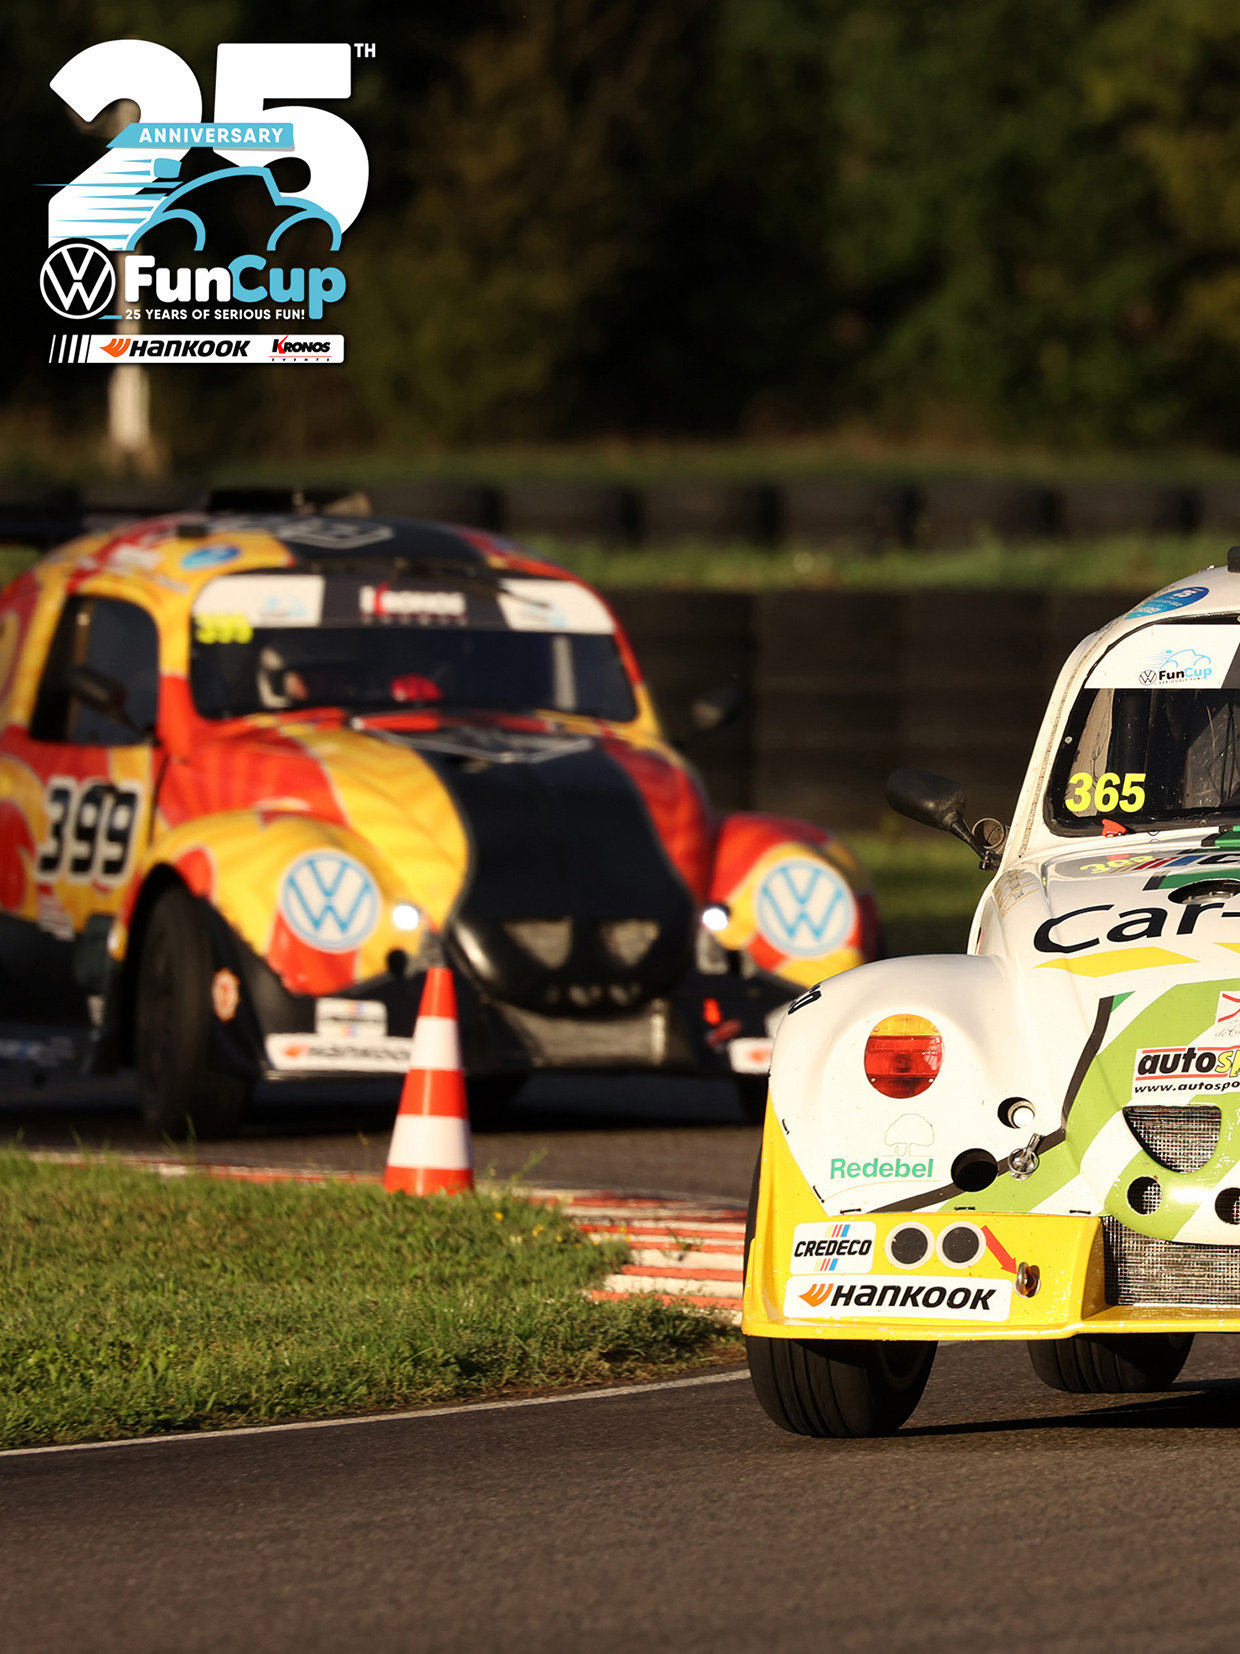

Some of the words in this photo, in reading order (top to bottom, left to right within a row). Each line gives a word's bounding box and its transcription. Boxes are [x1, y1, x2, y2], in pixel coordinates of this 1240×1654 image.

[1159, 667, 1212, 681] FunCup
[1065, 772, 1147, 813] 365
[38, 784, 140, 876] 399
[830, 1158, 934, 1179] Redebel
[793, 1239, 873, 1258] CREDECO
